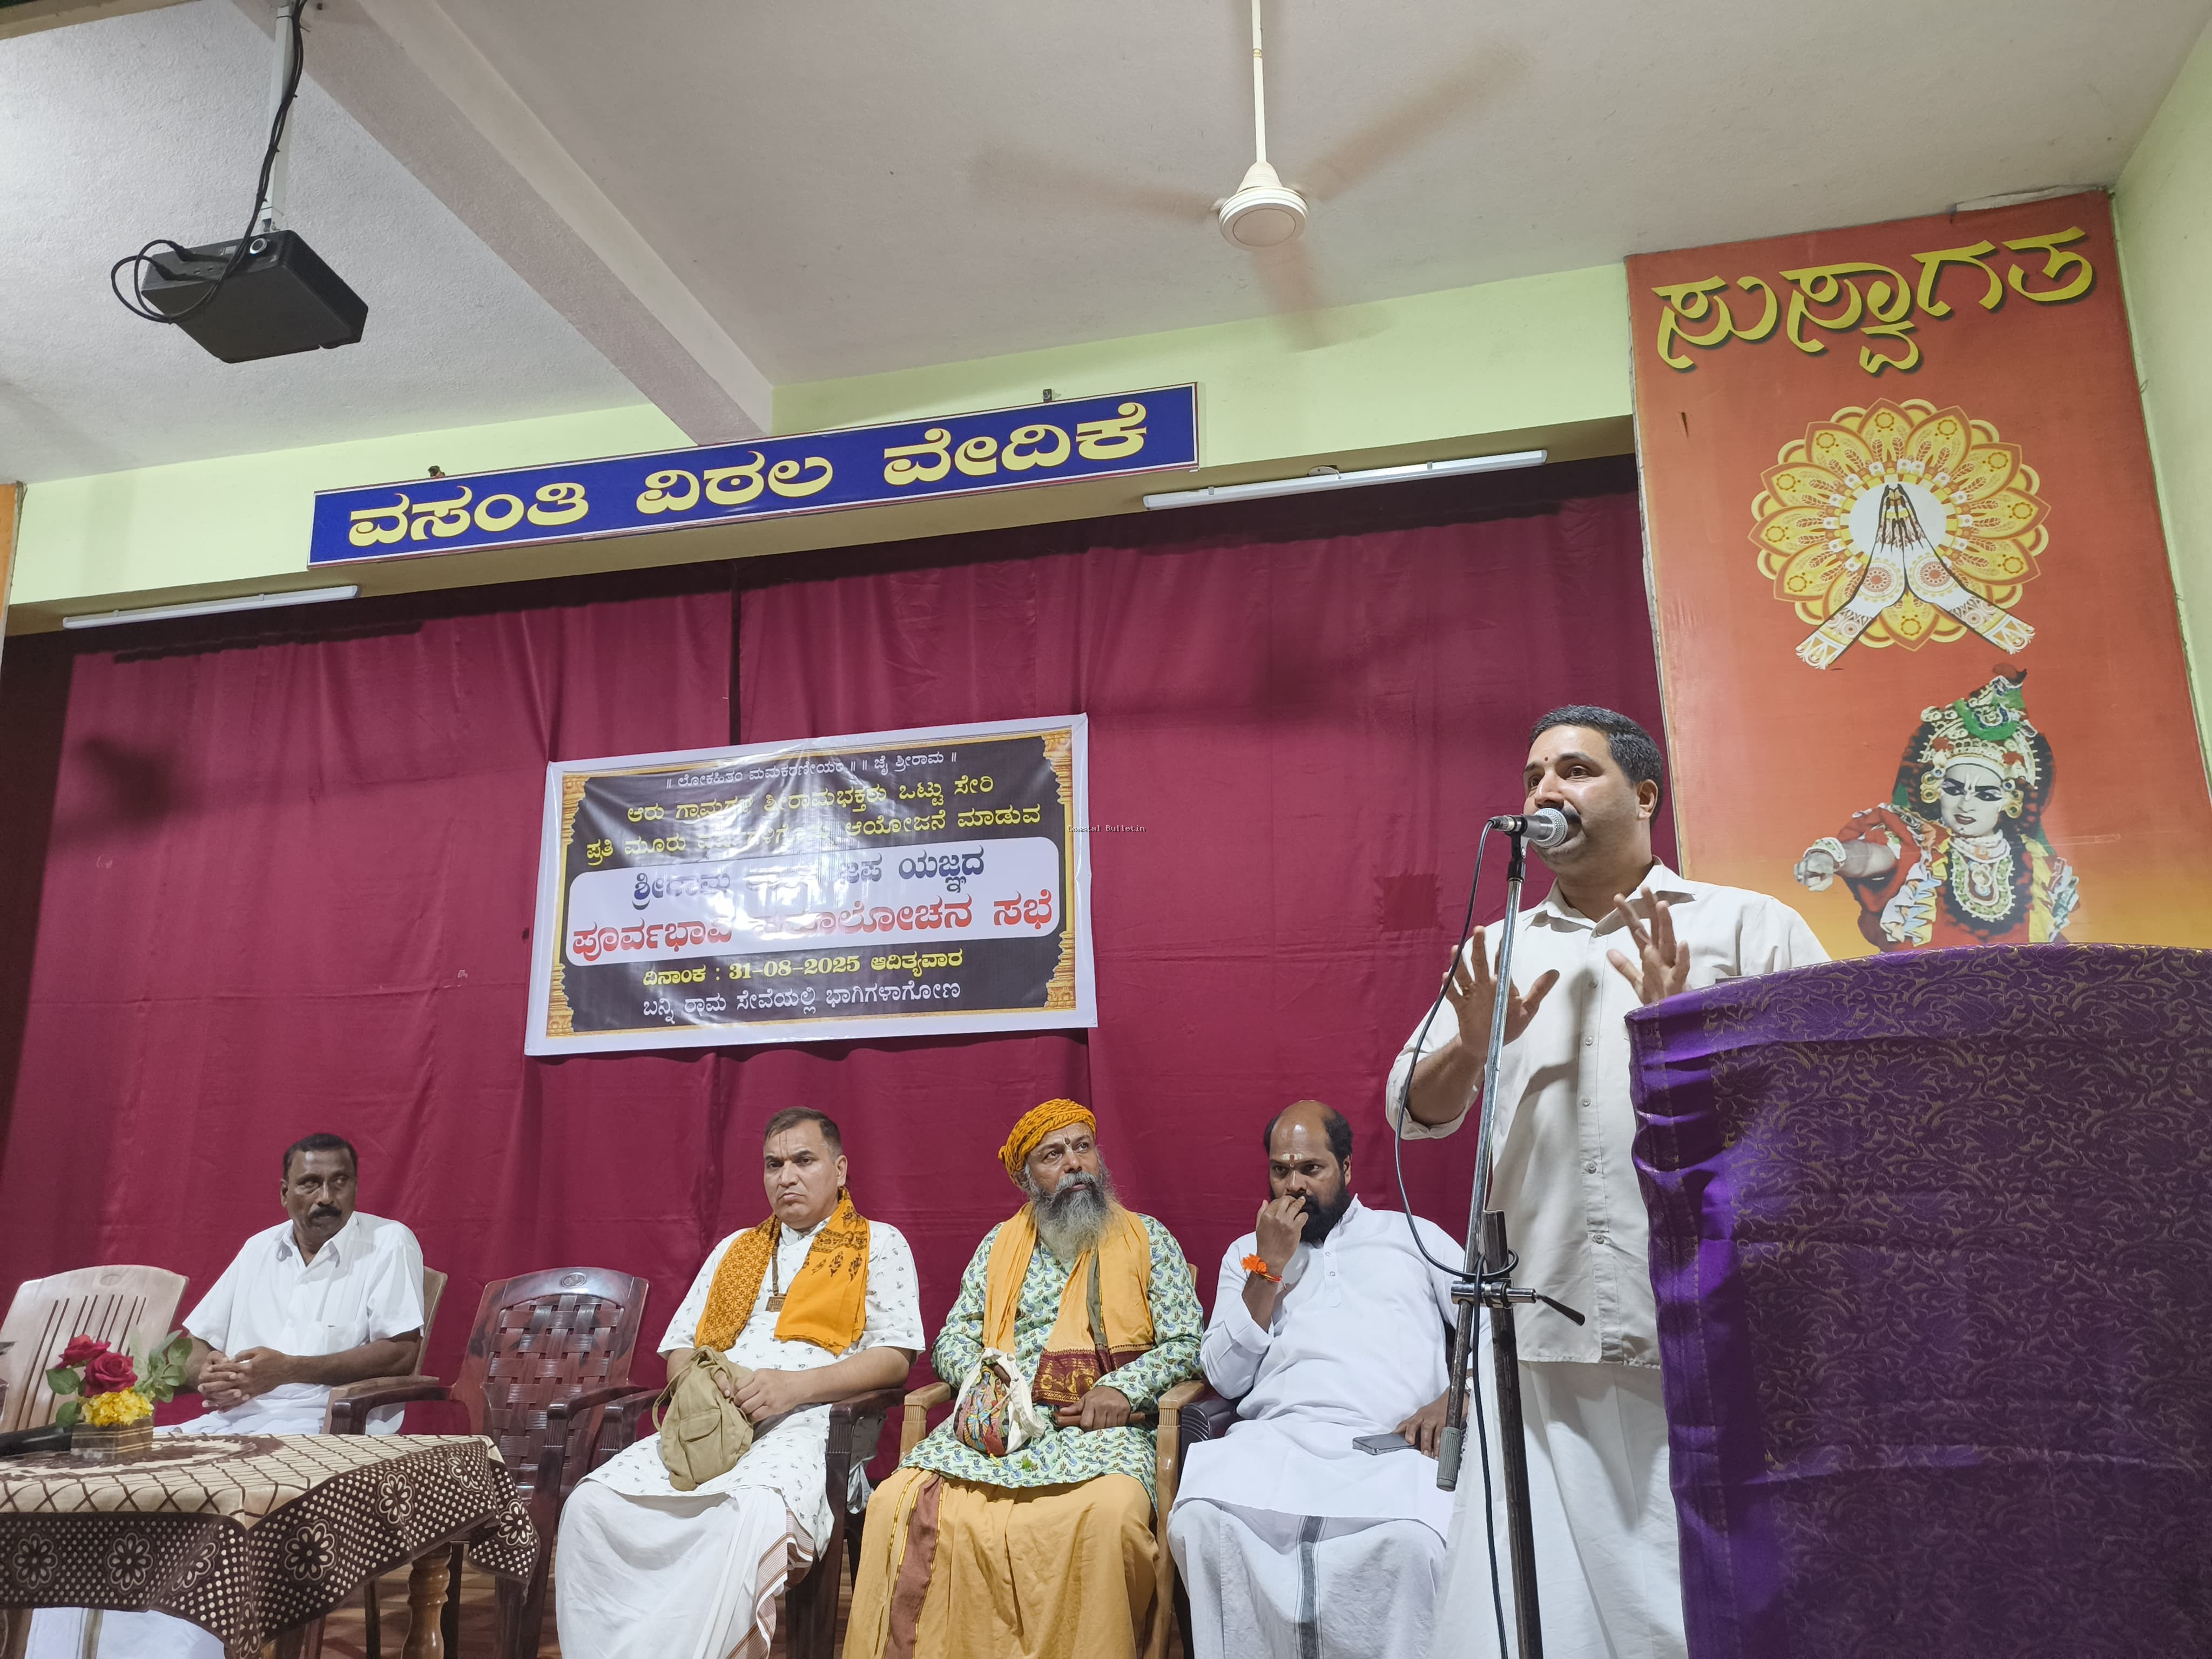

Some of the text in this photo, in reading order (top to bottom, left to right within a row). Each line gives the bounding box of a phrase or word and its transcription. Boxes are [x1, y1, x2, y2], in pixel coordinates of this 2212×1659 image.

[1650, 226, 2093, 374] ಸುಸ್ವಾಗತ
[349, 402, 1148, 547] ವಸಂತಿ ವಿಠಲ ವೇದಿಕೆ
[894, 751, 944, 772] ಶ್ರೀರಾಮ
[628, 802, 665, 822] ಆರು
[899, 781, 945, 807] ಒಟ್ಟು
[954, 774, 994, 795] ಸೇರಿ
[586, 838, 614, 867] ಪ್ರತಿ
[623, 832, 686, 855] ಮೂರು
[845, 808, 946, 837] ಆಯೋಜನೆ
[957, 803, 1041, 828] ಮಾಡುವ
[898, 845, 985, 893] ಯಜ್ಞದ
[994, 889, 1053, 930] ಸಭೆ
[643, 964, 707, 986] ದಿನಾಂಕ
[729, 954, 861, 980] 31-08-2025
[871, 948, 963, 977] ಆದಿತ್ಯವಾರ
[643, 997, 676, 1025] ಬನ್ನಿ
[737, 987, 817, 1014] ಸೇವೆಯಲ್ಲಿ
